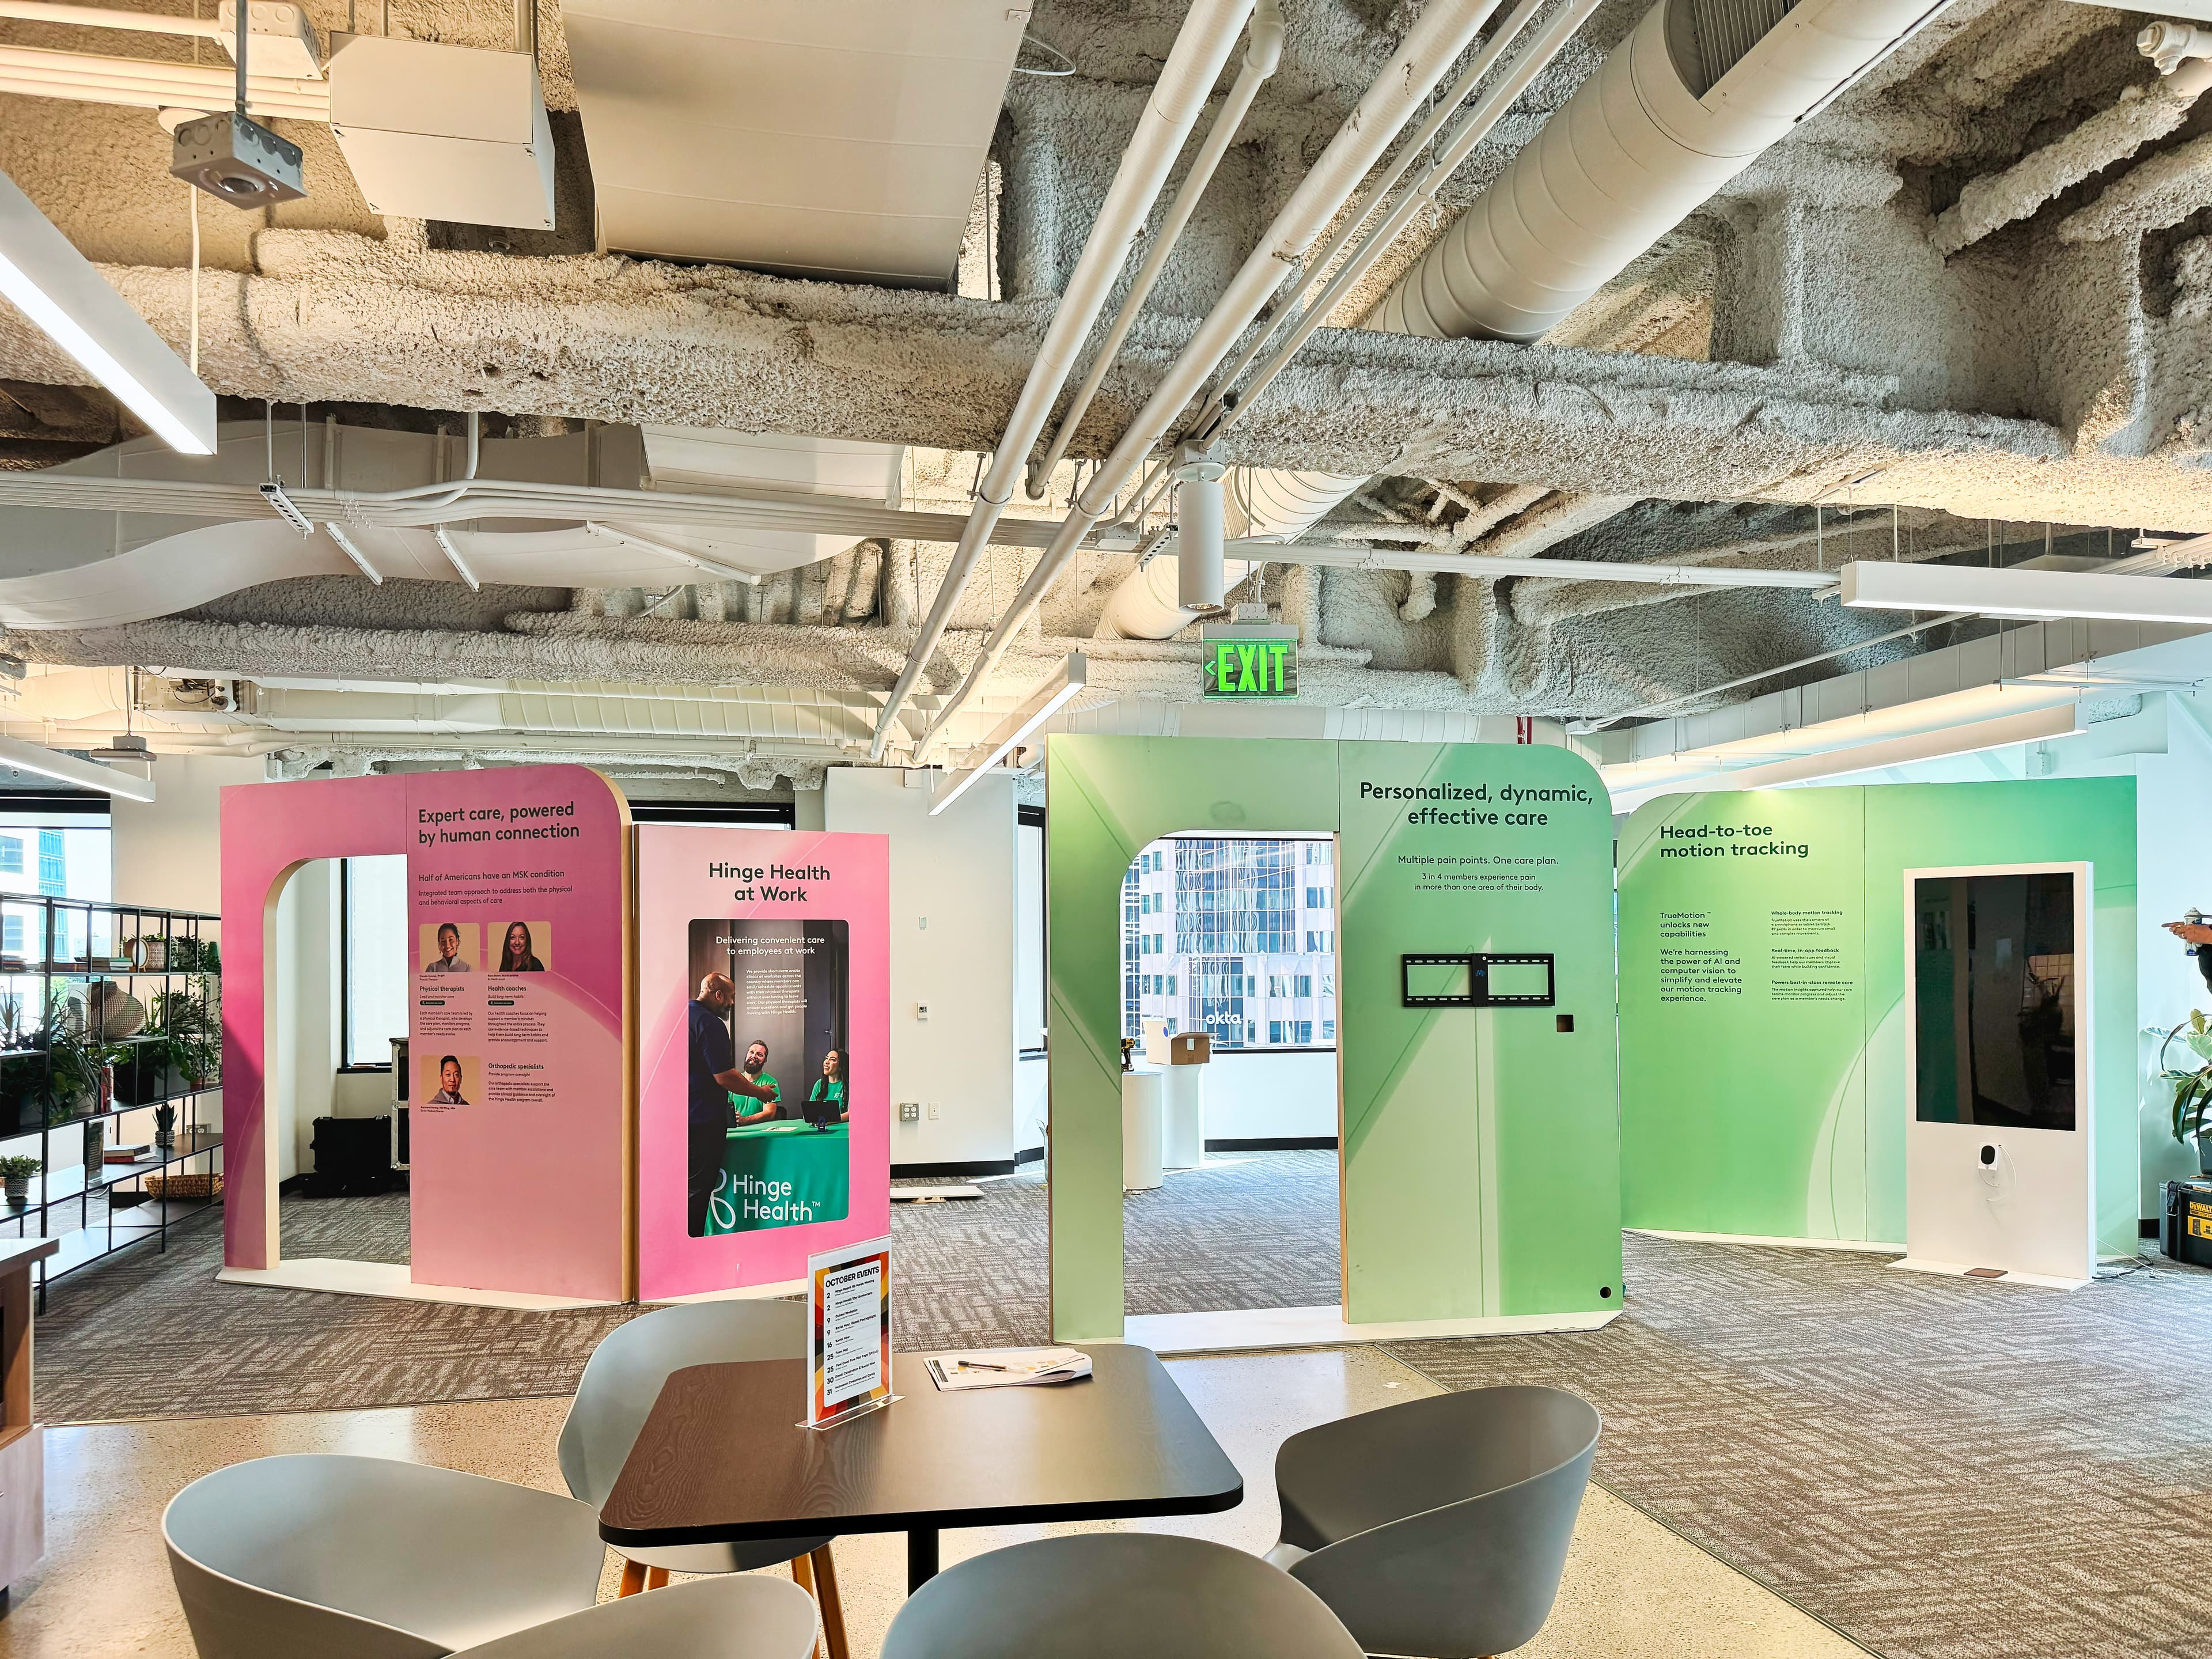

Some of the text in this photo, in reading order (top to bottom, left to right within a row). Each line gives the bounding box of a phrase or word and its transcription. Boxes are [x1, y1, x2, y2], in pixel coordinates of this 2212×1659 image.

[1217, 645, 1289, 692] EXIT
[1361, 782, 1593, 805] Personalized, dynamic,
[419, 801, 574, 826] Expert care, powered
[1408, 808, 1548, 825] effective care
[419, 824, 579, 847] by human connection
[1661, 824, 1772, 839] Head-to-toe
[1661, 841, 1808, 858] motion tracking
[1399, 855, 1434, 866] Multiple
[1438, 856, 1457, 866] pain
[1460, 856, 1490, 866] points.
[1537, 857, 1558, 866] plan.
[531, 870, 565, 878] condition
[710, 862, 830, 883] Hinge Health
[1480, 874, 1518, 882] experience
[1520, 874, 1535, 882] pain
[419, 889, 447, 897] Integrated
[464, 888, 491, 896] approach
[549, 885, 572, 894] physical
[734, 886, 808, 902] at Work
[1525, 884, 1543, 892] body.
[716, 936, 758, 945] Delivering
[760, 937, 805, 945] convenient
[1661, 930, 1706, 938] capabilities
[738, 947, 782, 956] employees
[796, 947, 815, 956] work
[1685, 949, 1728, 957] harnessing
[1661, 976, 1692, 984] simplify
[1708, 986, 1741, 994] tracking
[1206, 1012, 1242, 1025] okta
[733, 1175, 791, 1202] Hinge
[825, 1273, 856, 1288] OCTOBER
[857, 1266, 880, 1279] EVENTS
